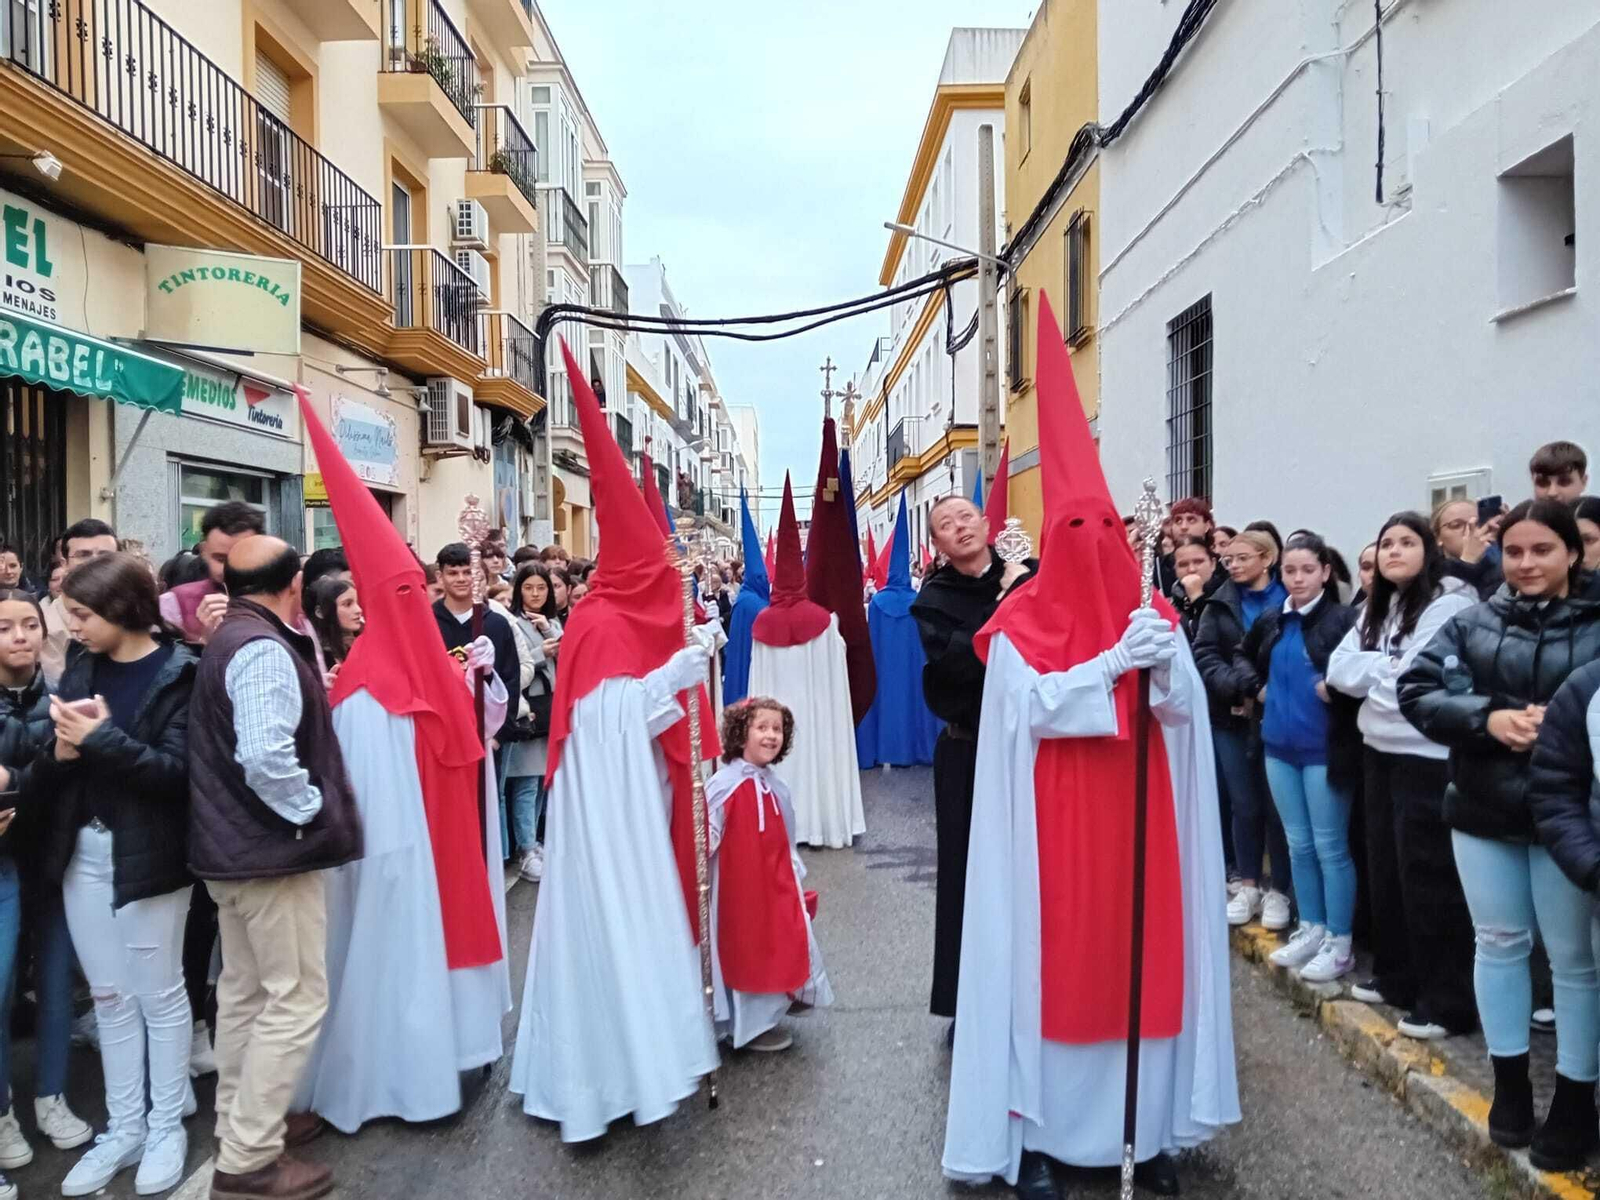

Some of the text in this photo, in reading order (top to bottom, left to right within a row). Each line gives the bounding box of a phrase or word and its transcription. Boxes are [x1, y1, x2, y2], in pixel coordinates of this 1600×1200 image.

[3, 204, 53, 278] EL
[3, 291, 57, 320] MENAJES
[158, 267, 290, 306] TINTORERIA
